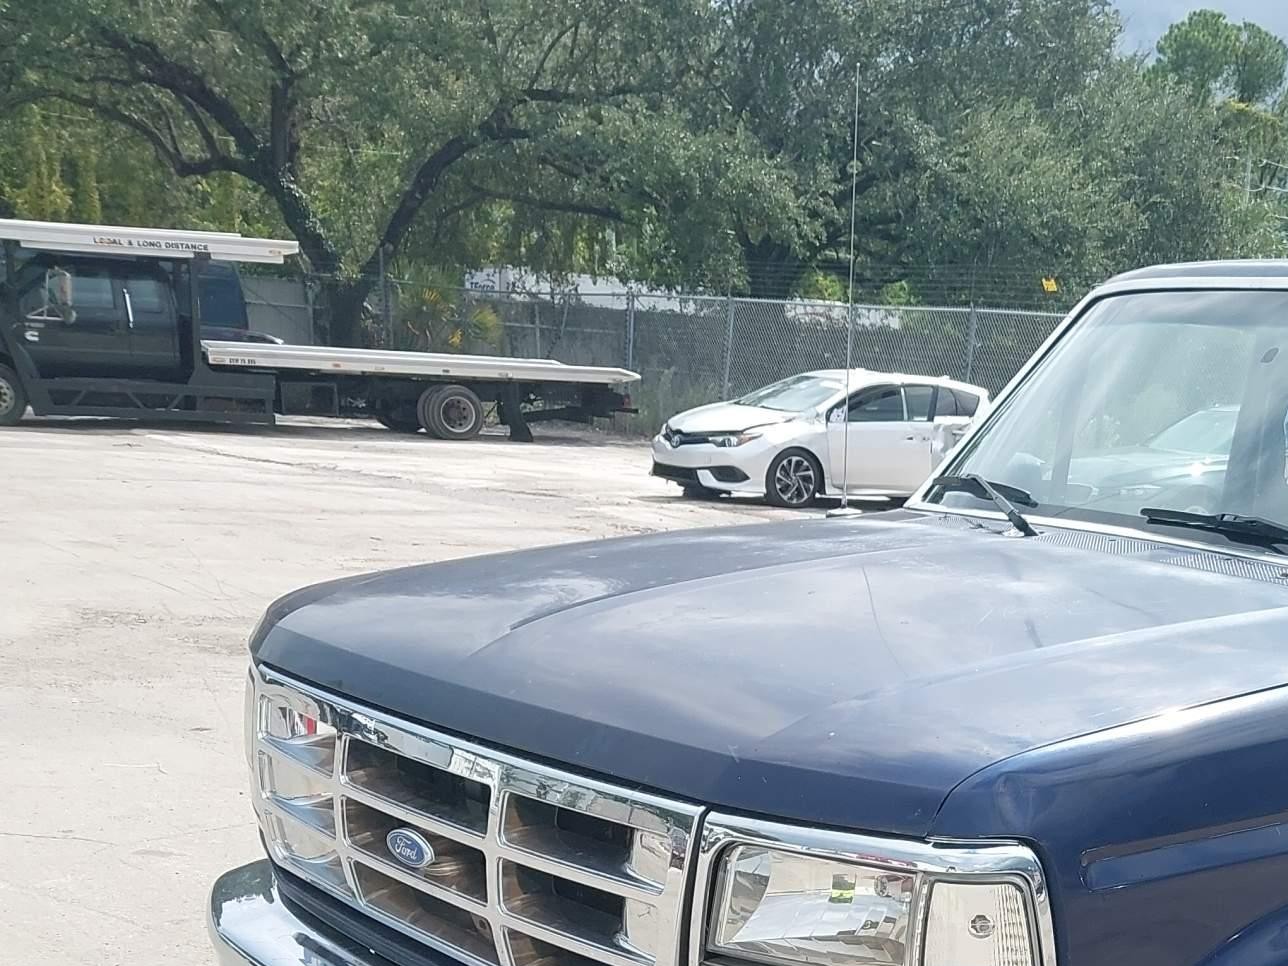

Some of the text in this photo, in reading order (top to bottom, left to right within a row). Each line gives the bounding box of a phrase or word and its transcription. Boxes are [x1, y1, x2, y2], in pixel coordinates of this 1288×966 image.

[137, 240, 162, 248] LONG
[165, 241, 209, 251] DISTANCE
[395, 836, 417, 860] Ford
